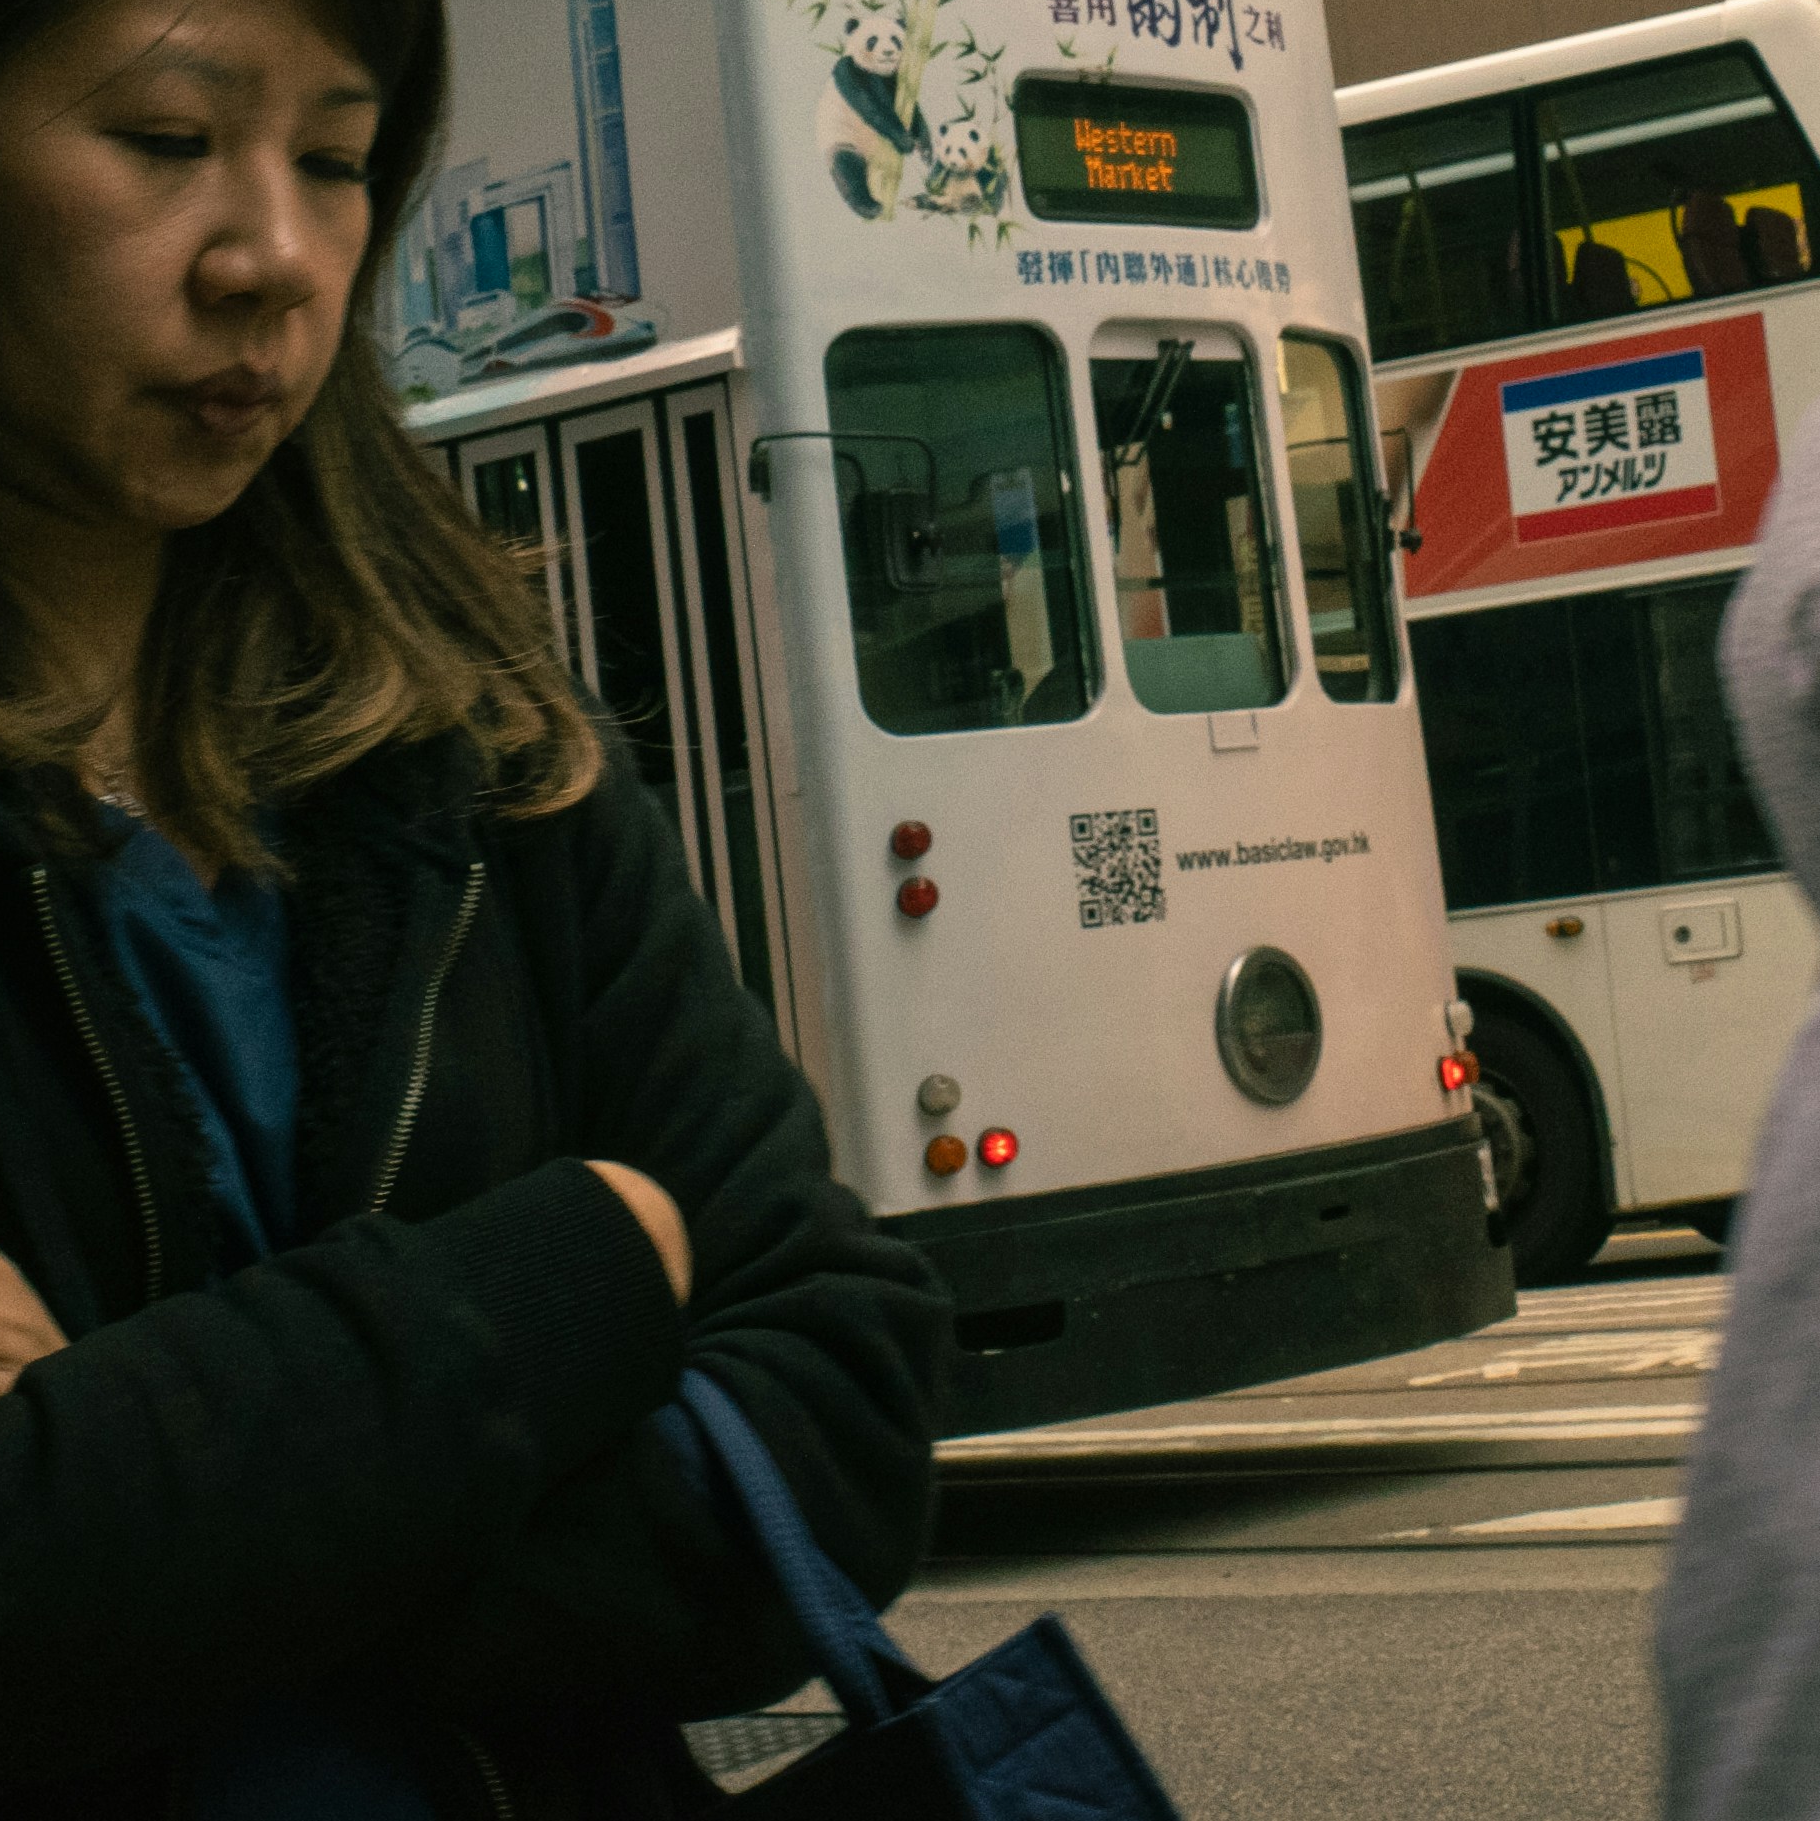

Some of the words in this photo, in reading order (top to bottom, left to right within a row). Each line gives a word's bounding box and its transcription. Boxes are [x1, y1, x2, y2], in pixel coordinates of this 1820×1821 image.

[1073, 118, 1177, 157] Western
[1085, 155, 1175, 193] Market
[1532, 390, 1682, 467] 安美露
[1556, 451, 1667, 503] アンメルツ
[1176, 831, 1370, 872] www.basiclaw.gov.hk
